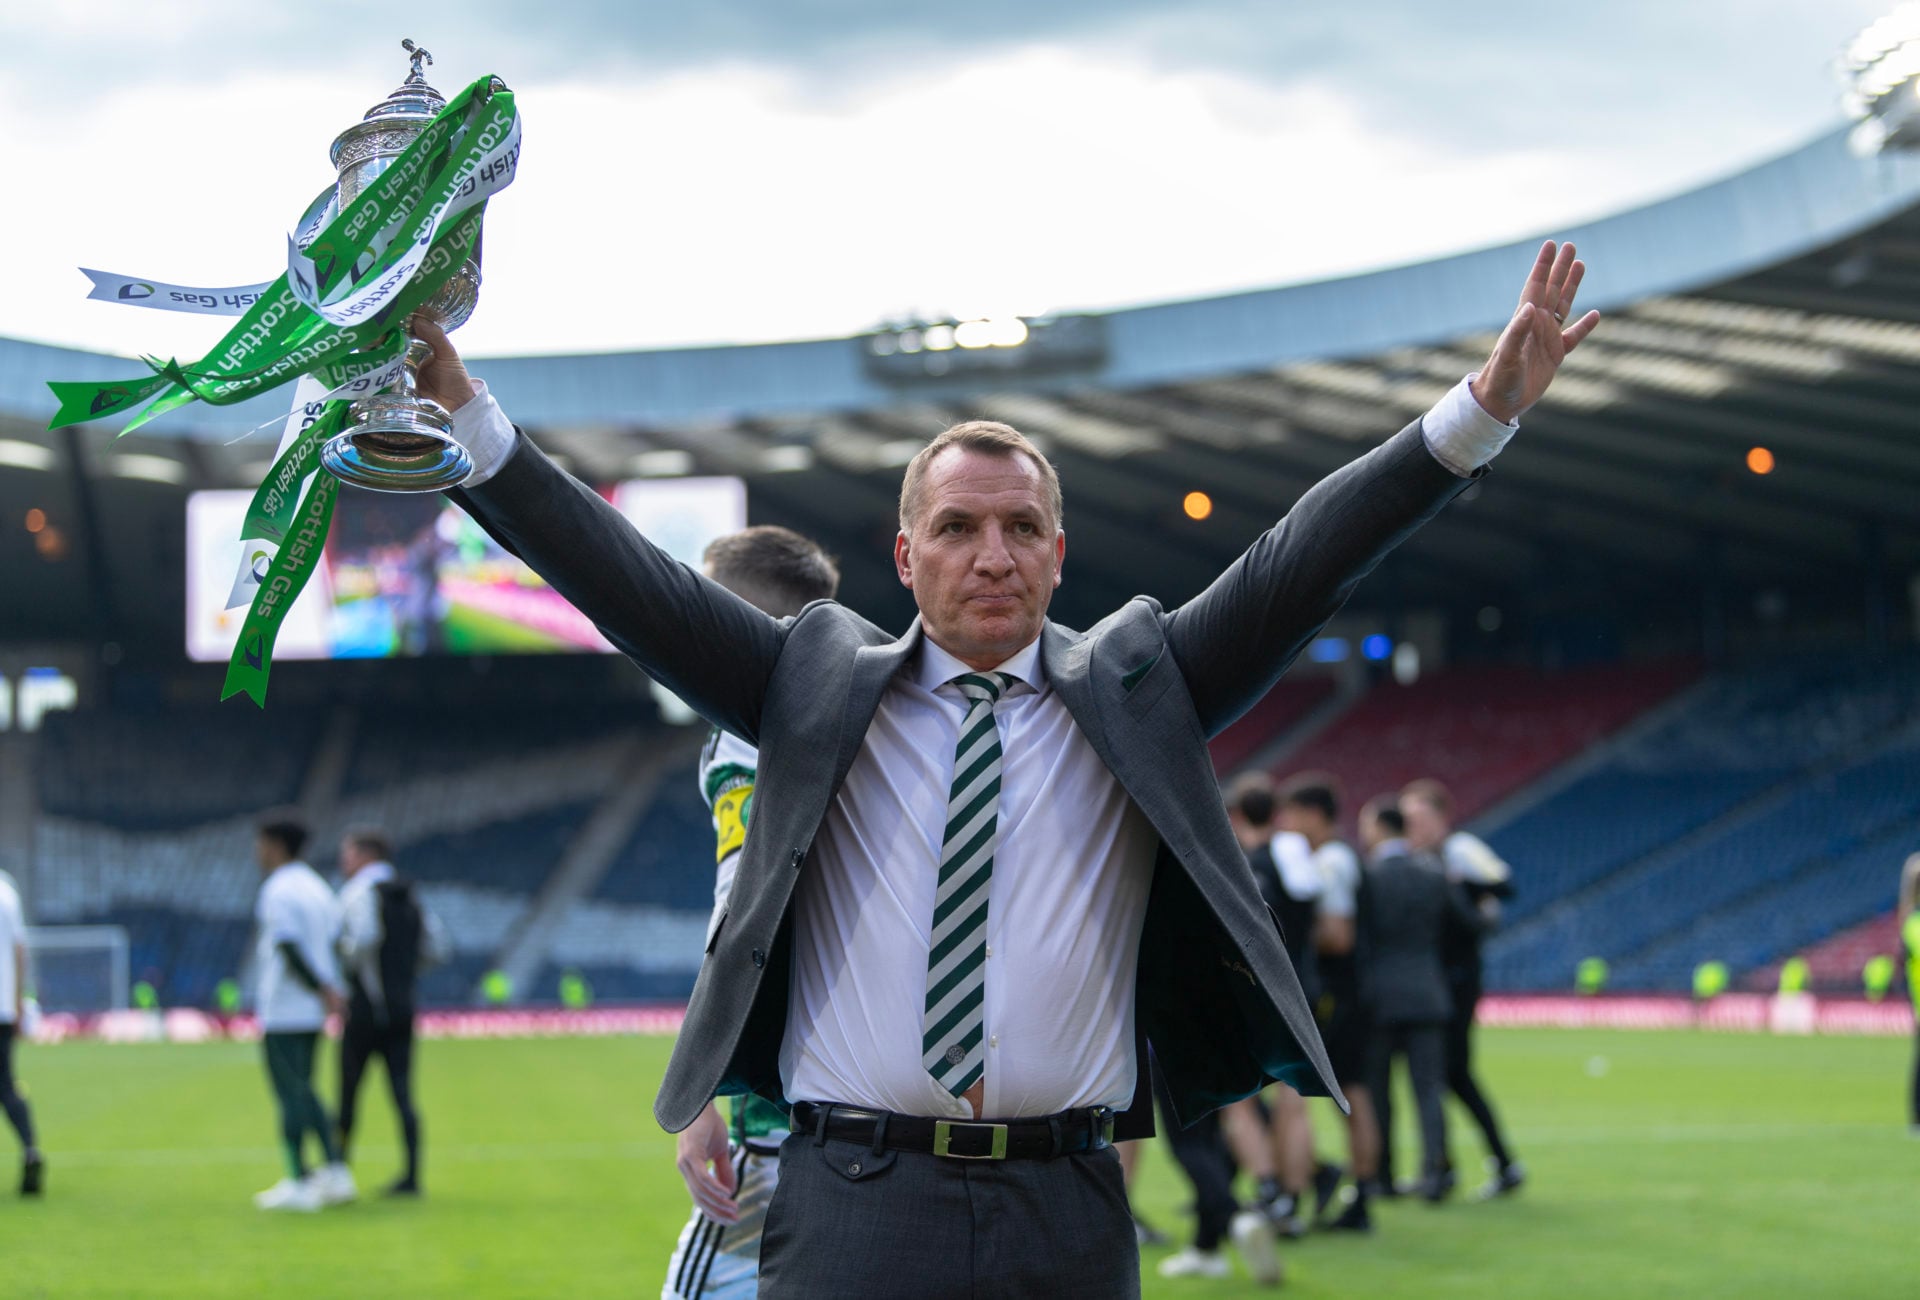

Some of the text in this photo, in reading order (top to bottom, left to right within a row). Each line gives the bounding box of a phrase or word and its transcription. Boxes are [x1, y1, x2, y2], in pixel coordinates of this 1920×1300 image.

[344, 120, 448, 241] Scottish Gas
[169, 292, 218, 308] Gas
[338, 263, 416, 317] Scottish
[217, 289, 302, 371] Scottish
[264, 326, 358, 377] Scottish
[276, 429, 328, 493] Scottish
[263, 487, 285, 518] Gas
[282, 475, 336, 572] Scottish
[258, 575, 292, 618] Gas
